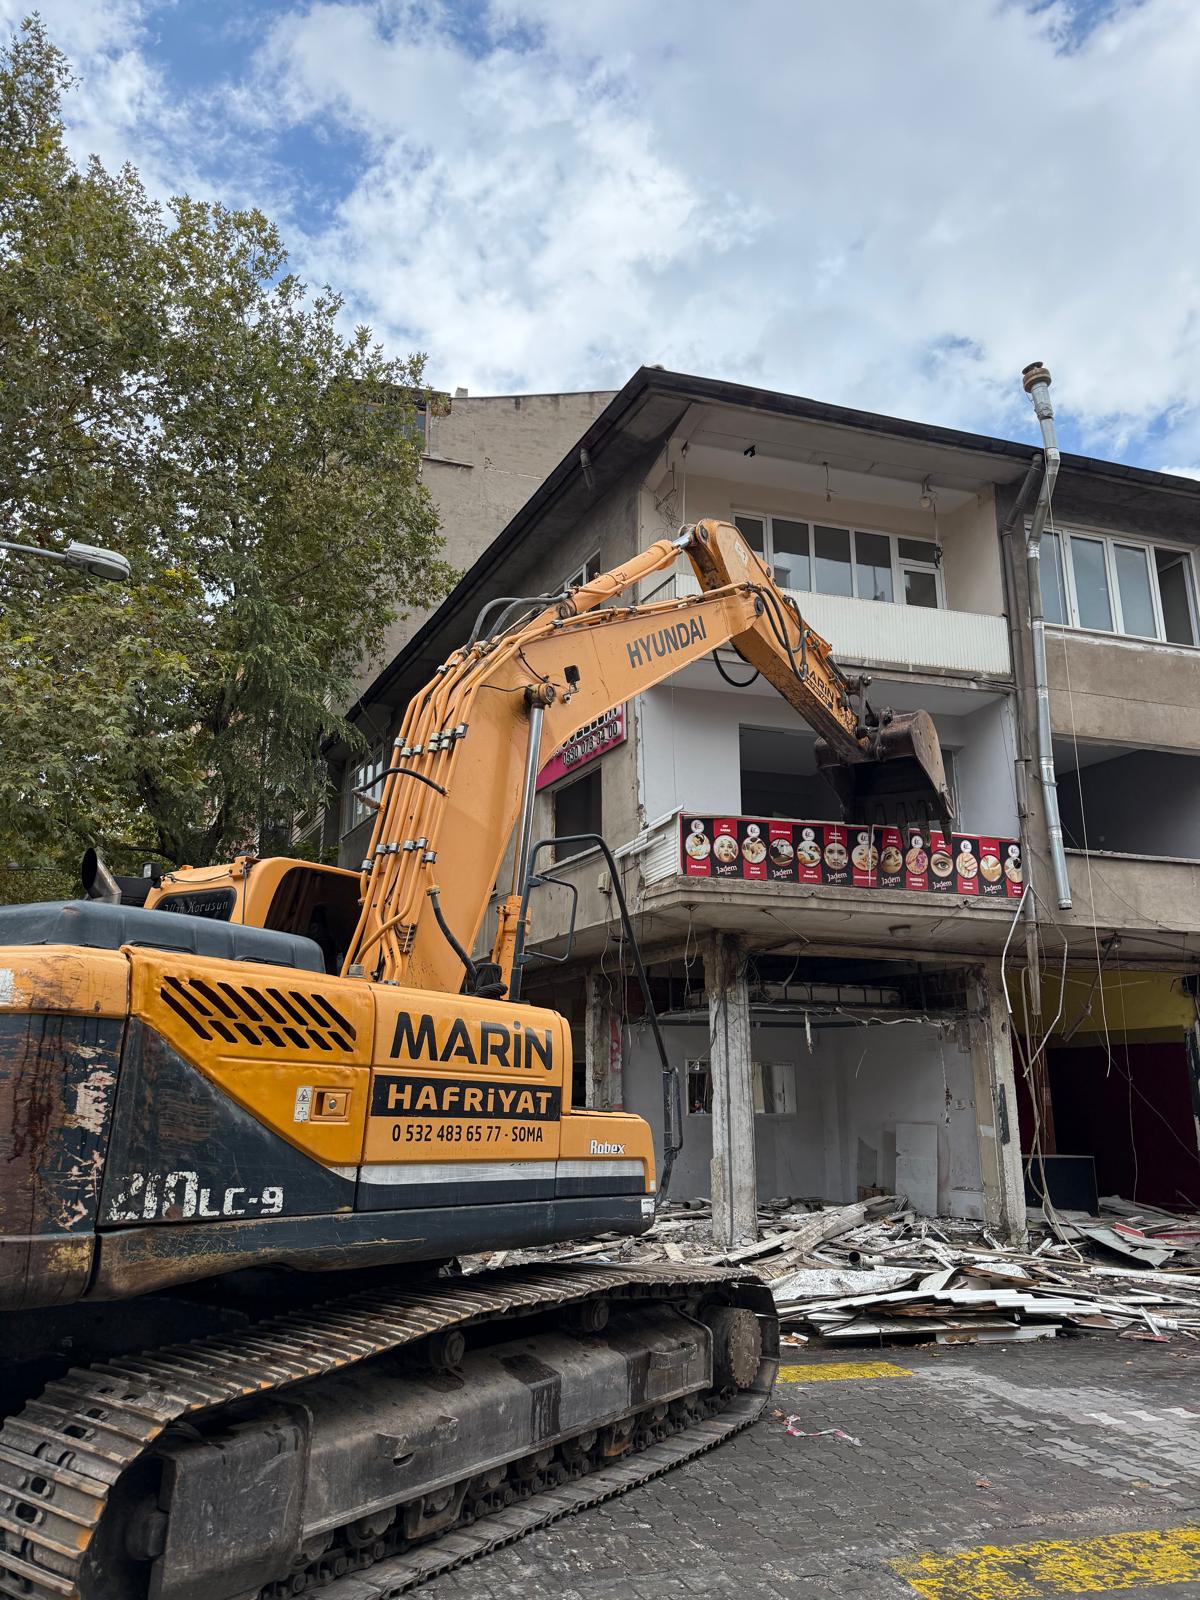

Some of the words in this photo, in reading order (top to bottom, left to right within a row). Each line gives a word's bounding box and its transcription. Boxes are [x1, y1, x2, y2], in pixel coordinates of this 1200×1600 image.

[626, 615, 707, 669] HYUNDAI
[187, 900, 229, 913] Korusun
[392, 1124, 401, 1142] 0
[405, 1124, 433, 1142] 532
[436, 1124, 462, 1142] 483
[466, 1125, 482, 1142] 65
[486, 1126, 502, 1142] 77
[511, 1126, 543, 1143] SOMA
[590, 1139, 626, 1155] Robex
